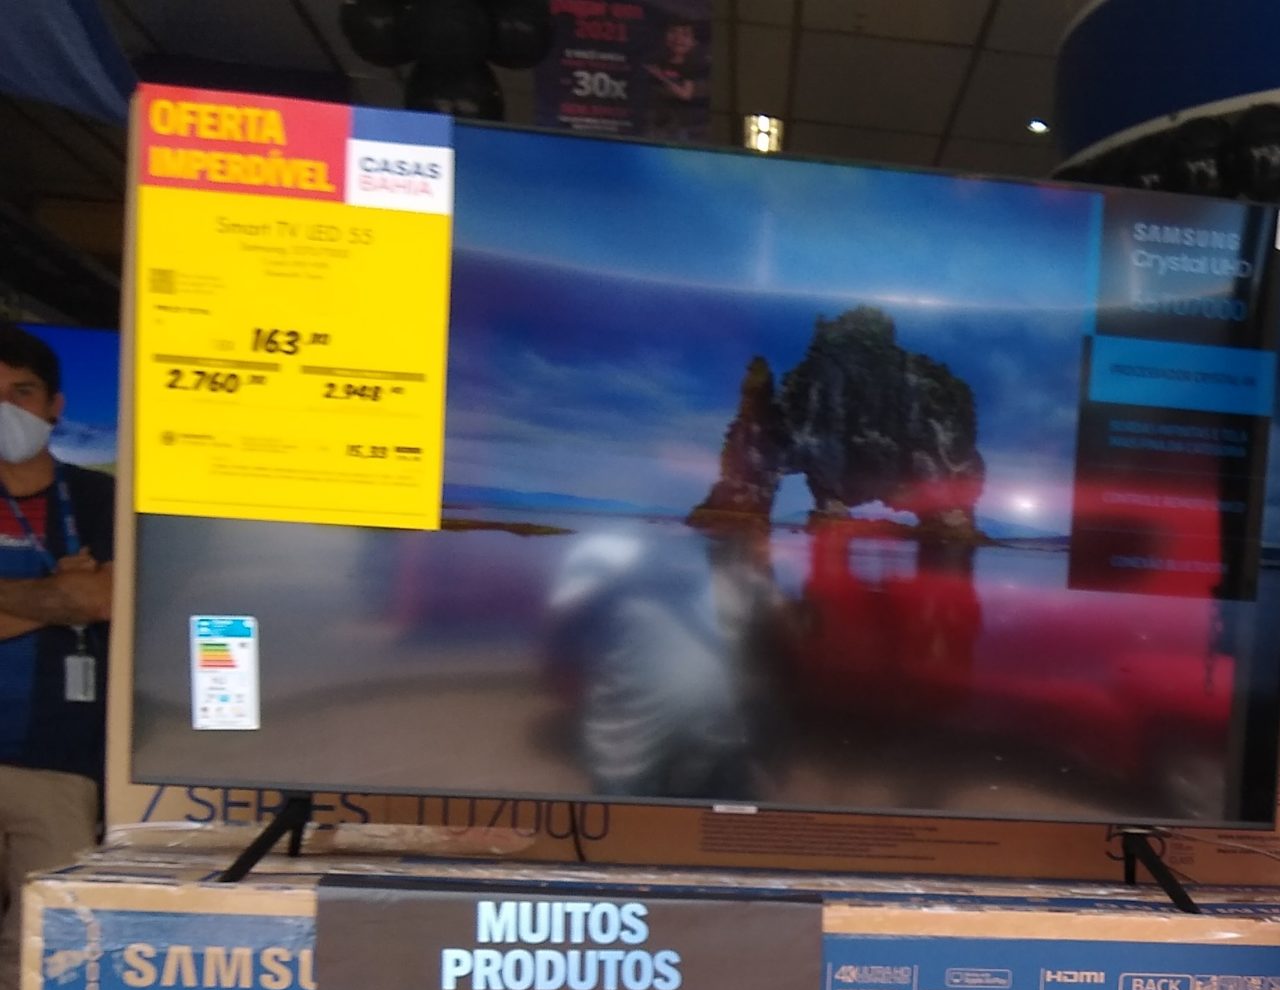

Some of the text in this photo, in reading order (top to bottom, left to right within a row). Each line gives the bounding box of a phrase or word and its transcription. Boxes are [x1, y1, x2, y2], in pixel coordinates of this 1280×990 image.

[149, 99, 287, 146] OFERTA
[149, 146, 337, 193] IMPERDÍVEL
[359, 156, 442, 180] CASAS
[359, 175, 434, 196] BAHIA
[1133, 223, 1240, 250] SAMSUNG
[476, 901, 650, 945] MUITOS
[1045, 971, 1105, 983] HDMI
